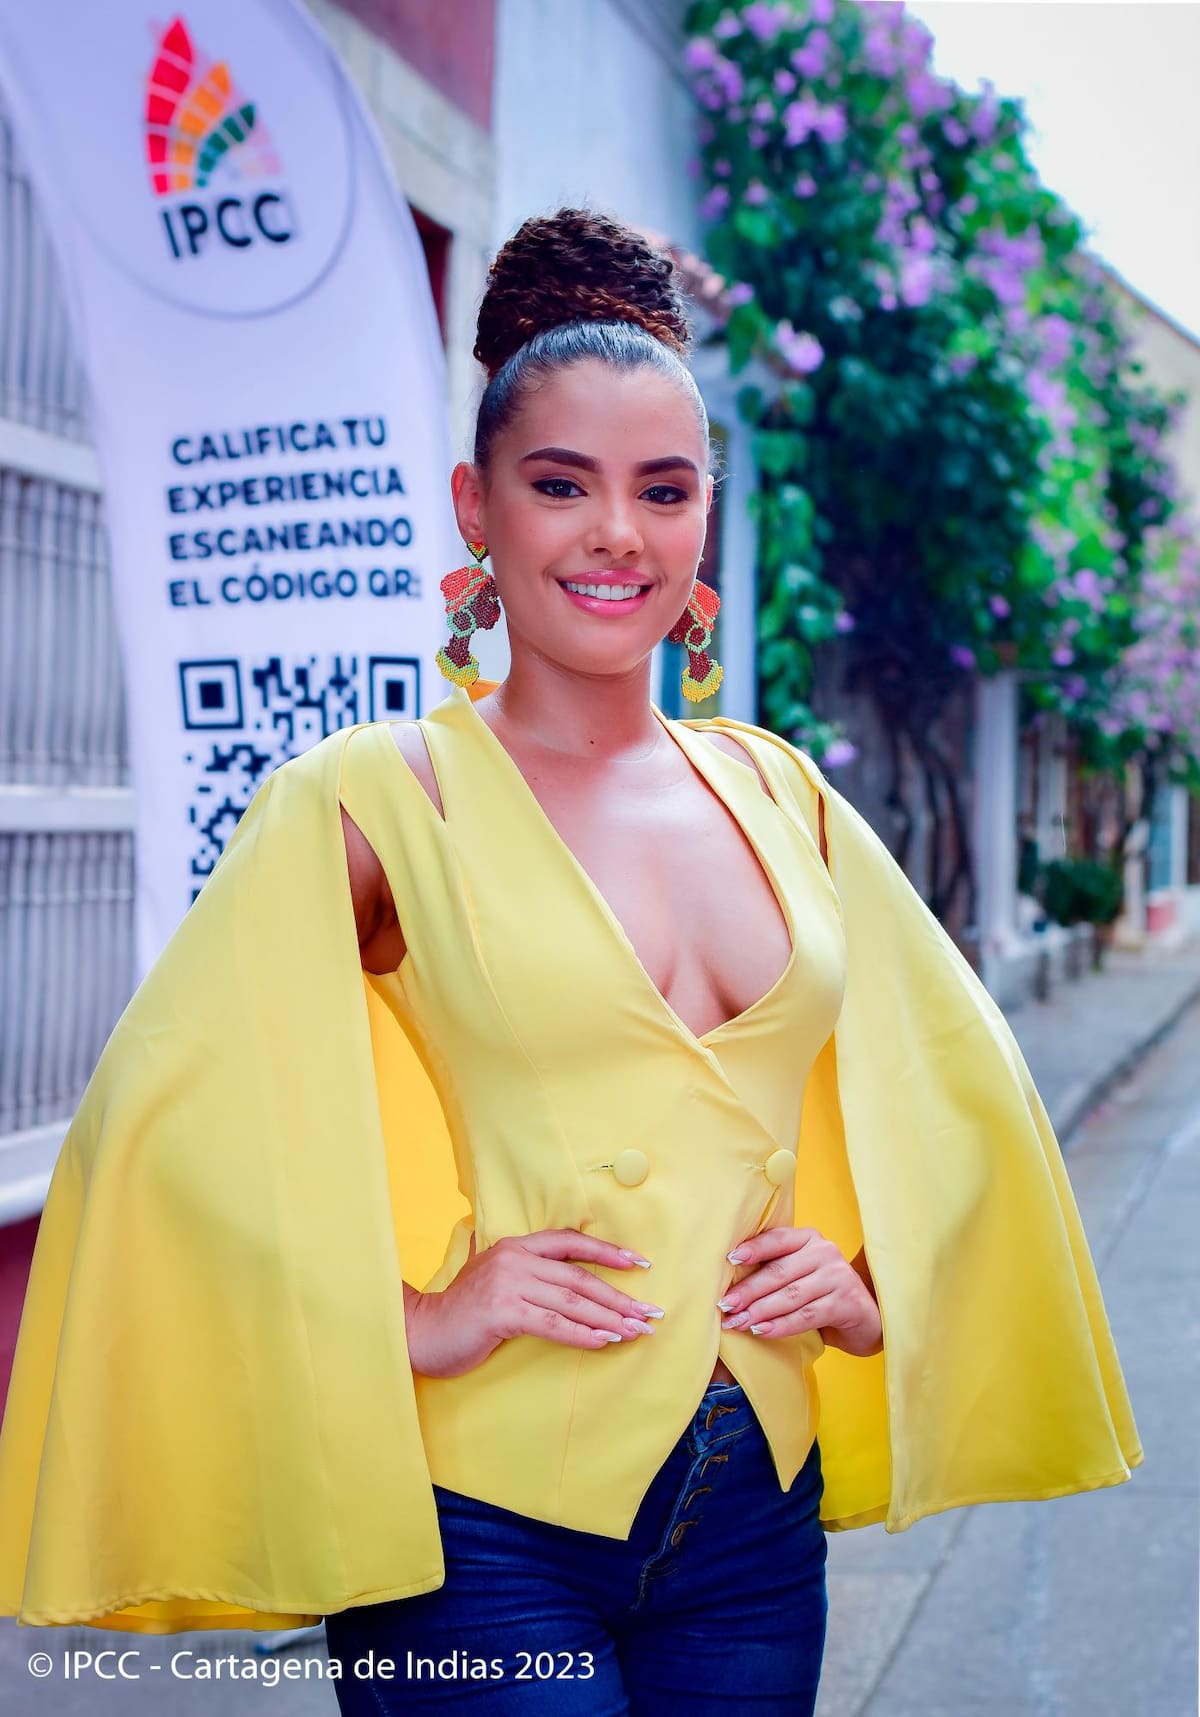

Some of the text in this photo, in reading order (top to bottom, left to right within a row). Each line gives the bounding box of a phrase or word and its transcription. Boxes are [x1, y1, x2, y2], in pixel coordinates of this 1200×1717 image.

[162, 193, 291, 259] IPCC
[172, 417, 386, 465] CALIFICA TU
[167, 467, 406, 514] EXPERIENCIA
[168, 517, 413, 561] ESCANEANDO
[168, 580, 211, 607] EL
[221, 563, 358, 603] CÓDIGO
